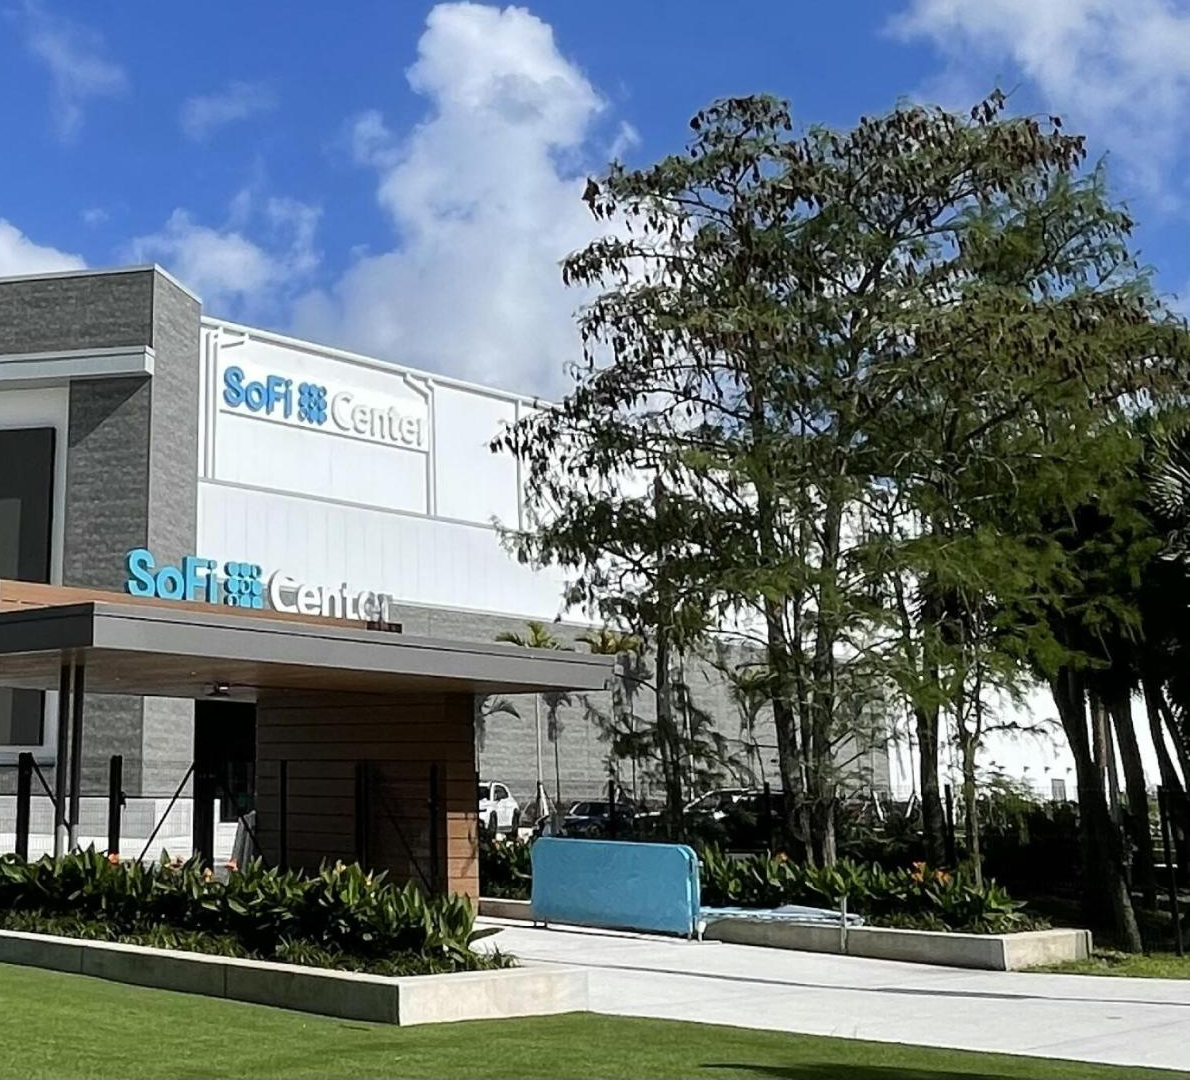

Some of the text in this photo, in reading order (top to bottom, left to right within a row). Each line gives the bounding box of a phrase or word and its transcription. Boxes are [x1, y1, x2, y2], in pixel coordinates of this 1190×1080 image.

[223, 366, 425, 447] SoFi Center
[126, 548, 394, 623] SoFi Center
